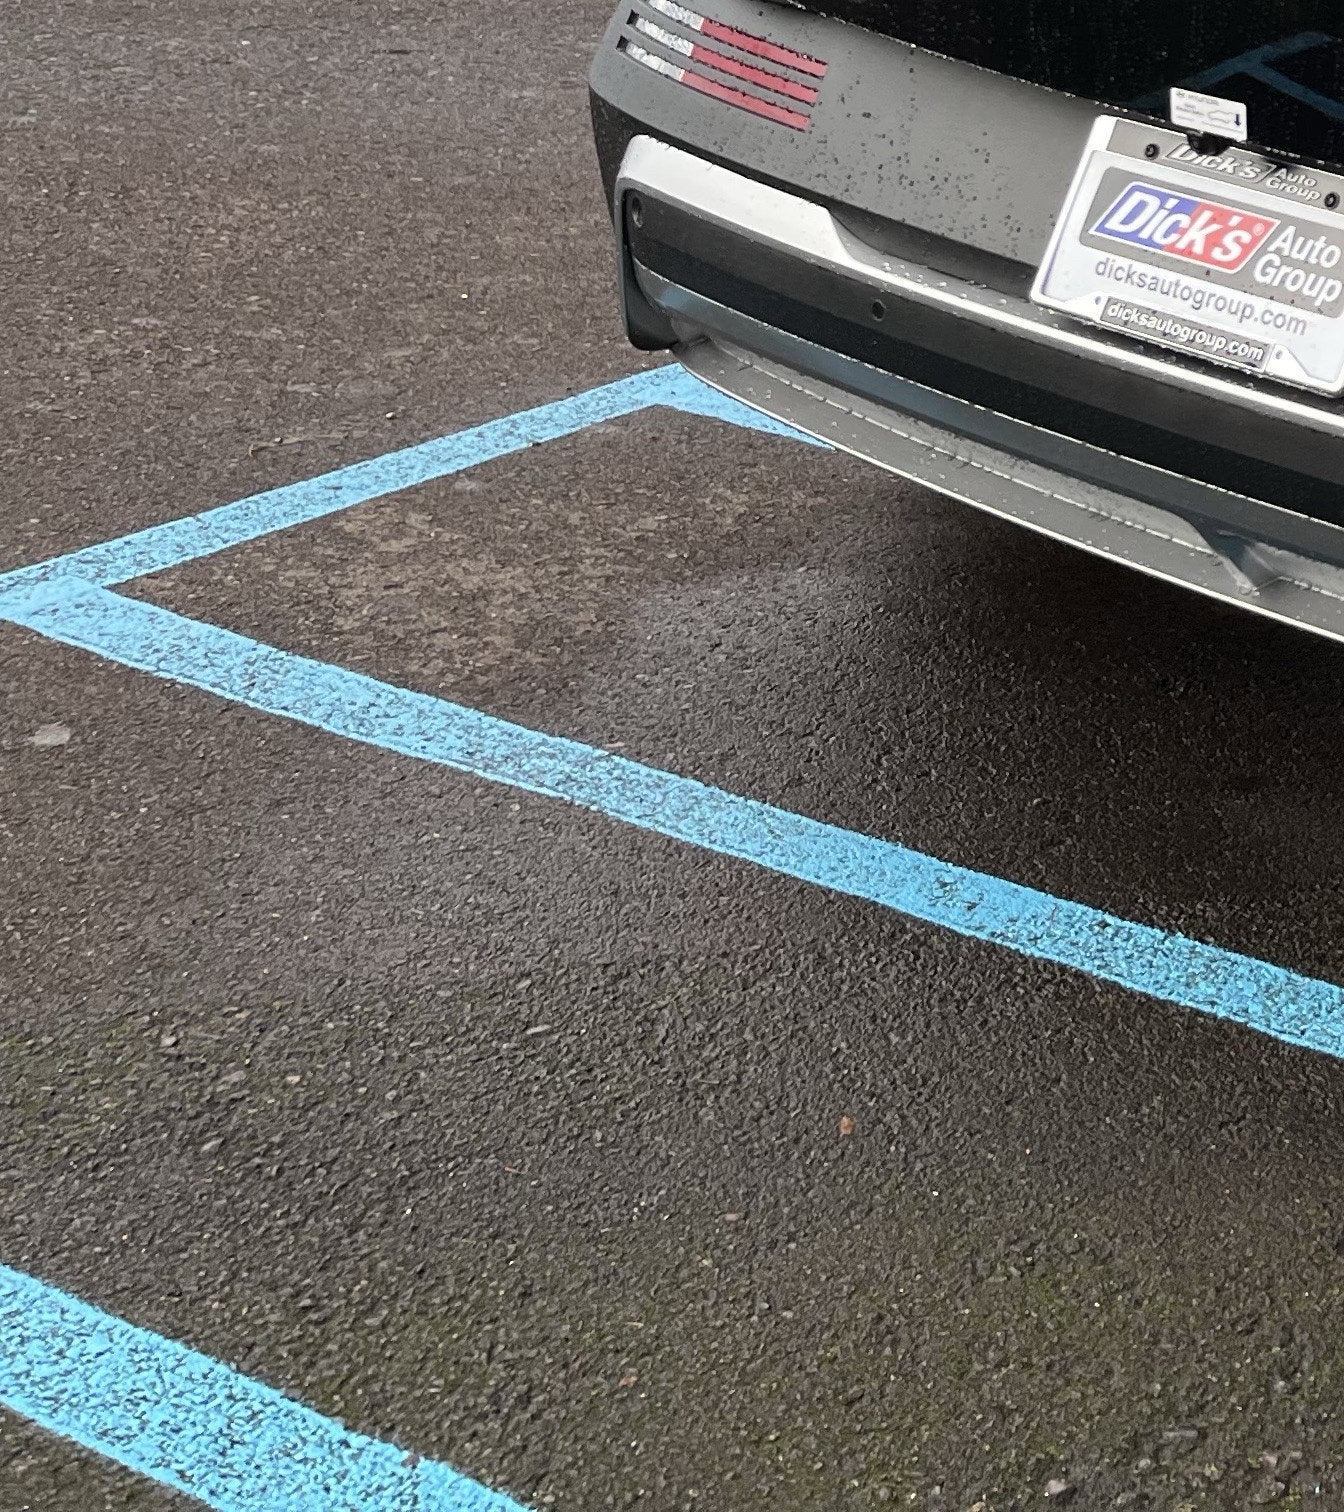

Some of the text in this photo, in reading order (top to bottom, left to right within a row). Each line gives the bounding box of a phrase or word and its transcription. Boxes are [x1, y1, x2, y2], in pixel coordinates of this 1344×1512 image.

[1265, 177, 1322, 201] Group
[1274, 167, 1318, 188] Auto
[1104, 190, 1342, 269] Dick's Auto
[1095, 257, 1308, 336] dicksautogroup.com
[1253, 253, 1343, 306] Group
[1107, 302, 1264, 362] dicksautogroup.com
